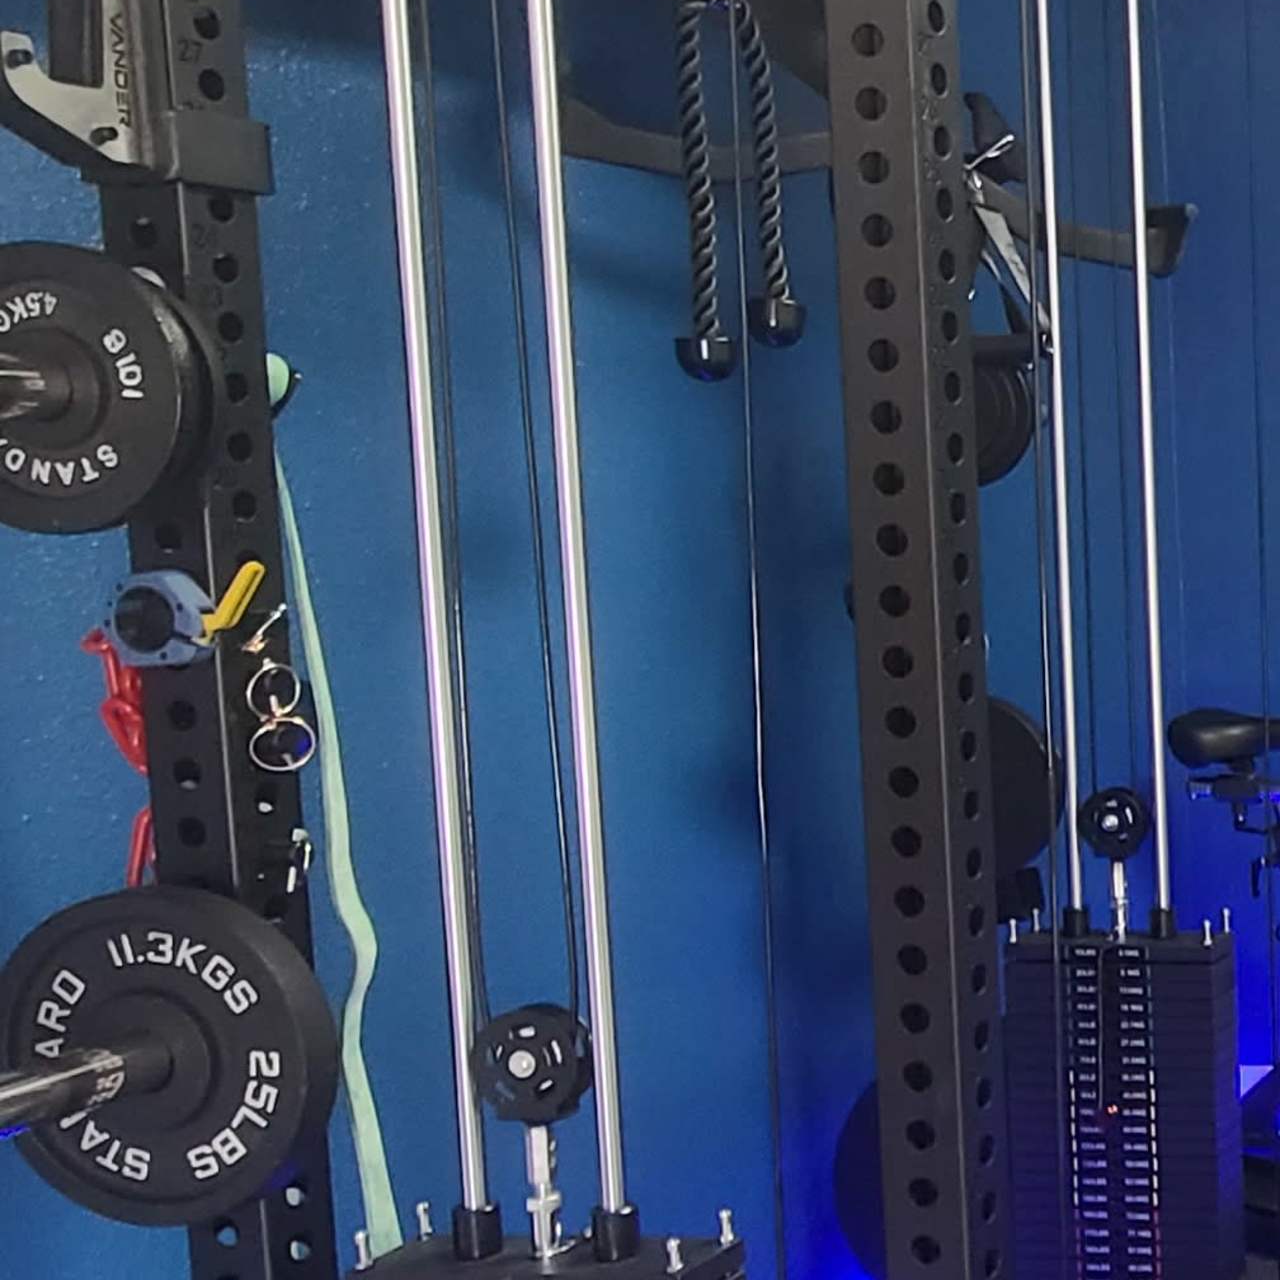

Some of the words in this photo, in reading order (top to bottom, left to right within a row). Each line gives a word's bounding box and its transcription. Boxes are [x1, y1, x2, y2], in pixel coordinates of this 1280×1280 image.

[109, 12, 132, 129] VANDER
[177, 38, 205, 66] 27
[0, 438, 119, 486] STAND
[106, 930, 259, 1015] 11.3KGS
[186, 1049, 281, 1180] 25LBS
